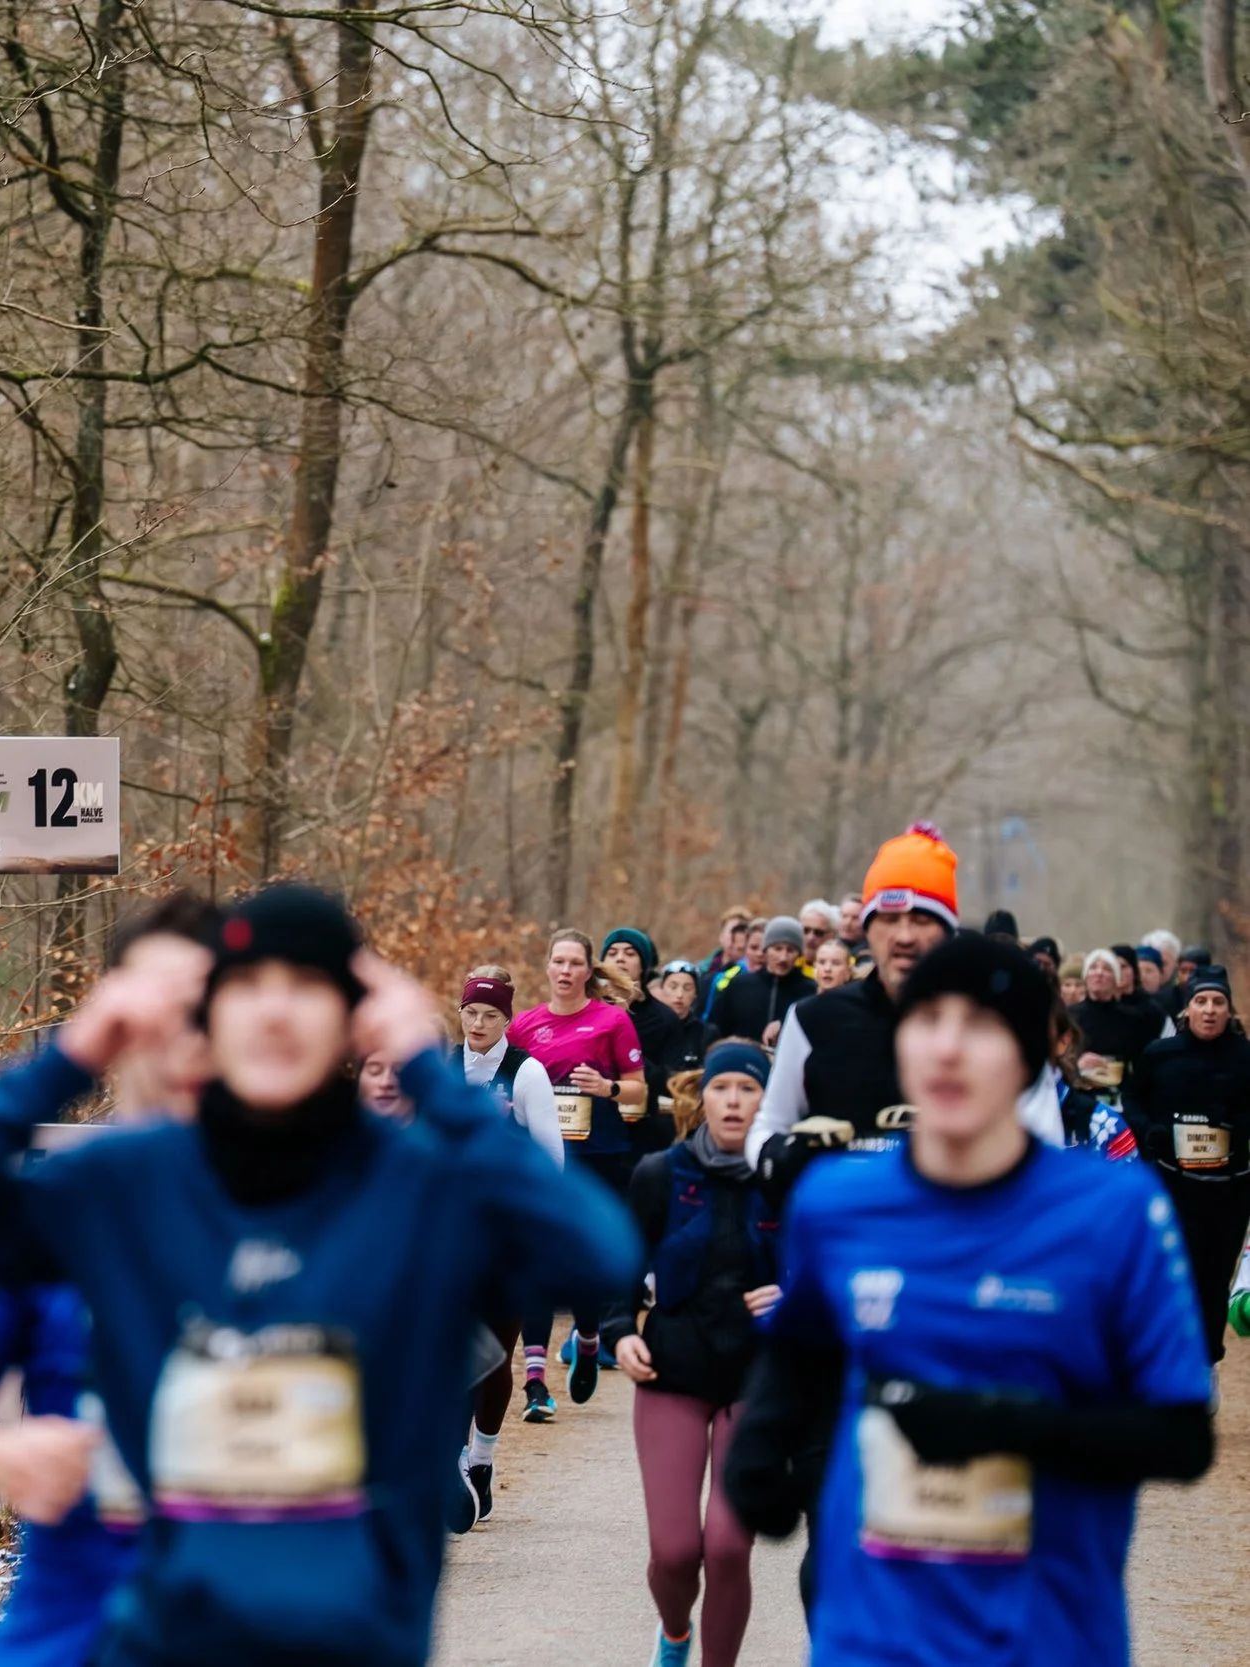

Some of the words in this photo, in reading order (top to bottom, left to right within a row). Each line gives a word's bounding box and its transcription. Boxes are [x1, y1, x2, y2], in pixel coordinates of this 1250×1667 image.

[28, 768, 78, 827] 12
[73, 782, 104, 807] KM
[80, 807, 103, 817] HALVE
